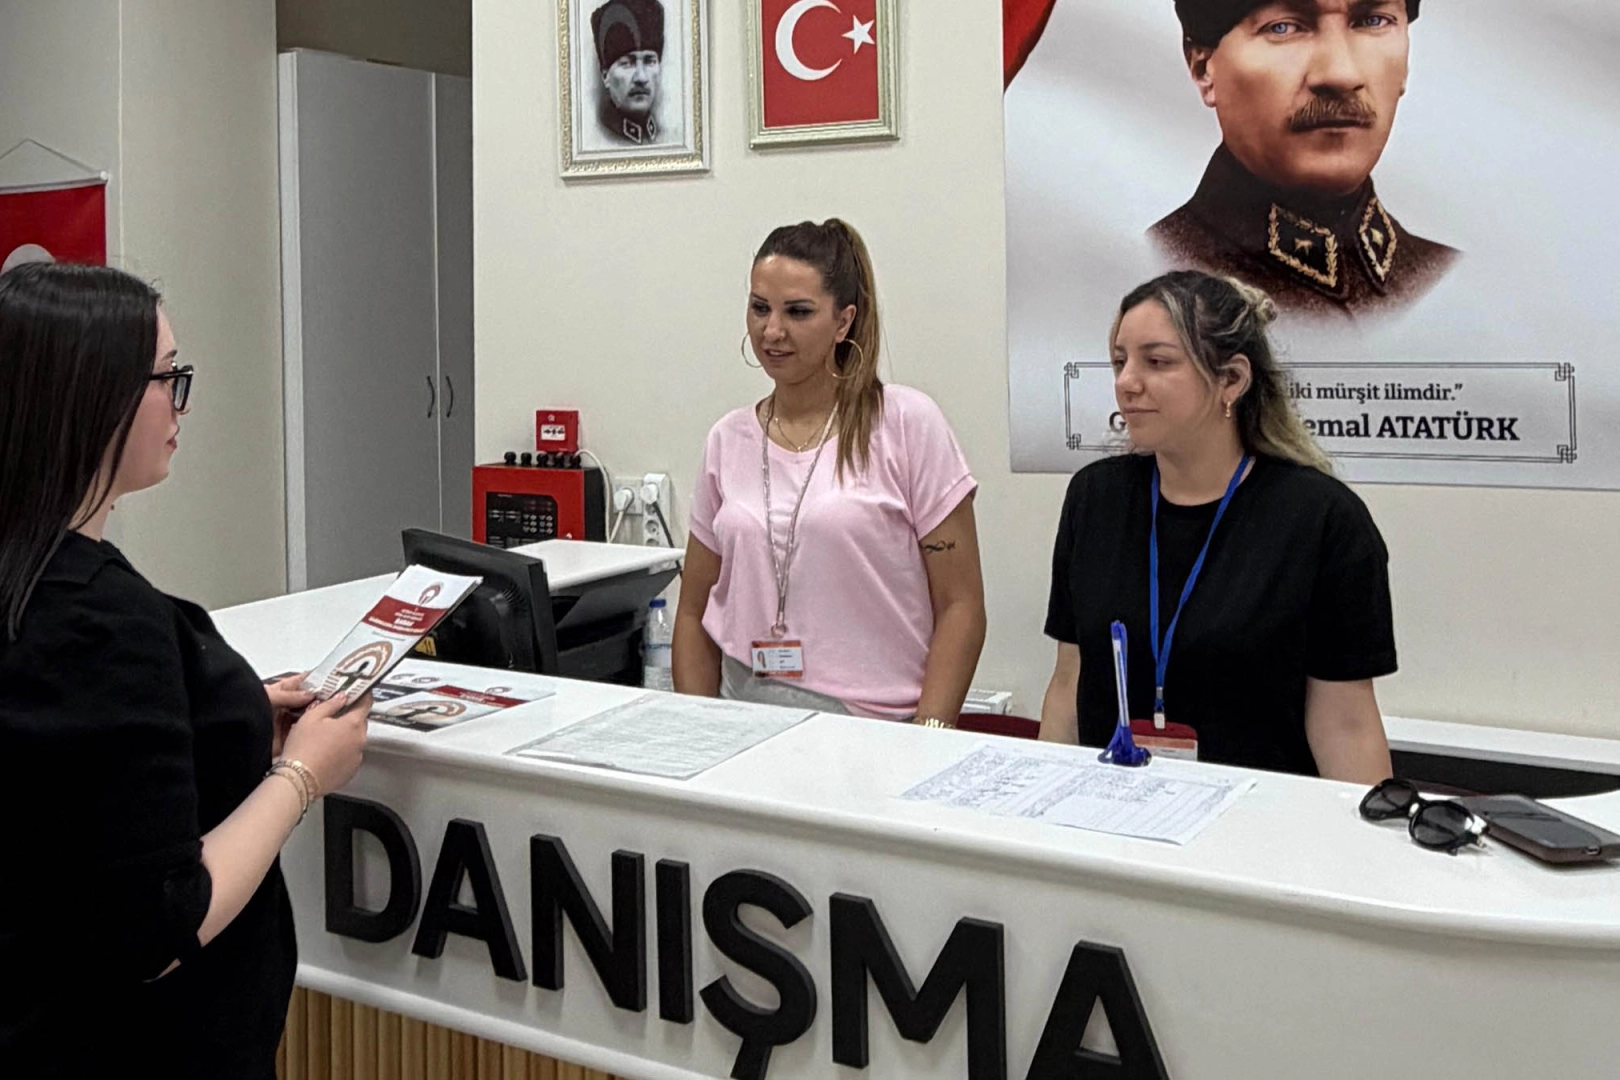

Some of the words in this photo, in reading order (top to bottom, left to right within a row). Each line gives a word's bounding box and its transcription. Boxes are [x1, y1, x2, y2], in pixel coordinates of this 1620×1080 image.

[1316, 382, 1380, 404] mürşit
[1302, 413, 1371, 438] emal
[1376, 411, 1520, 440] ATATÜRK
[323, 791, 1171, 1080] DANIŞMA
